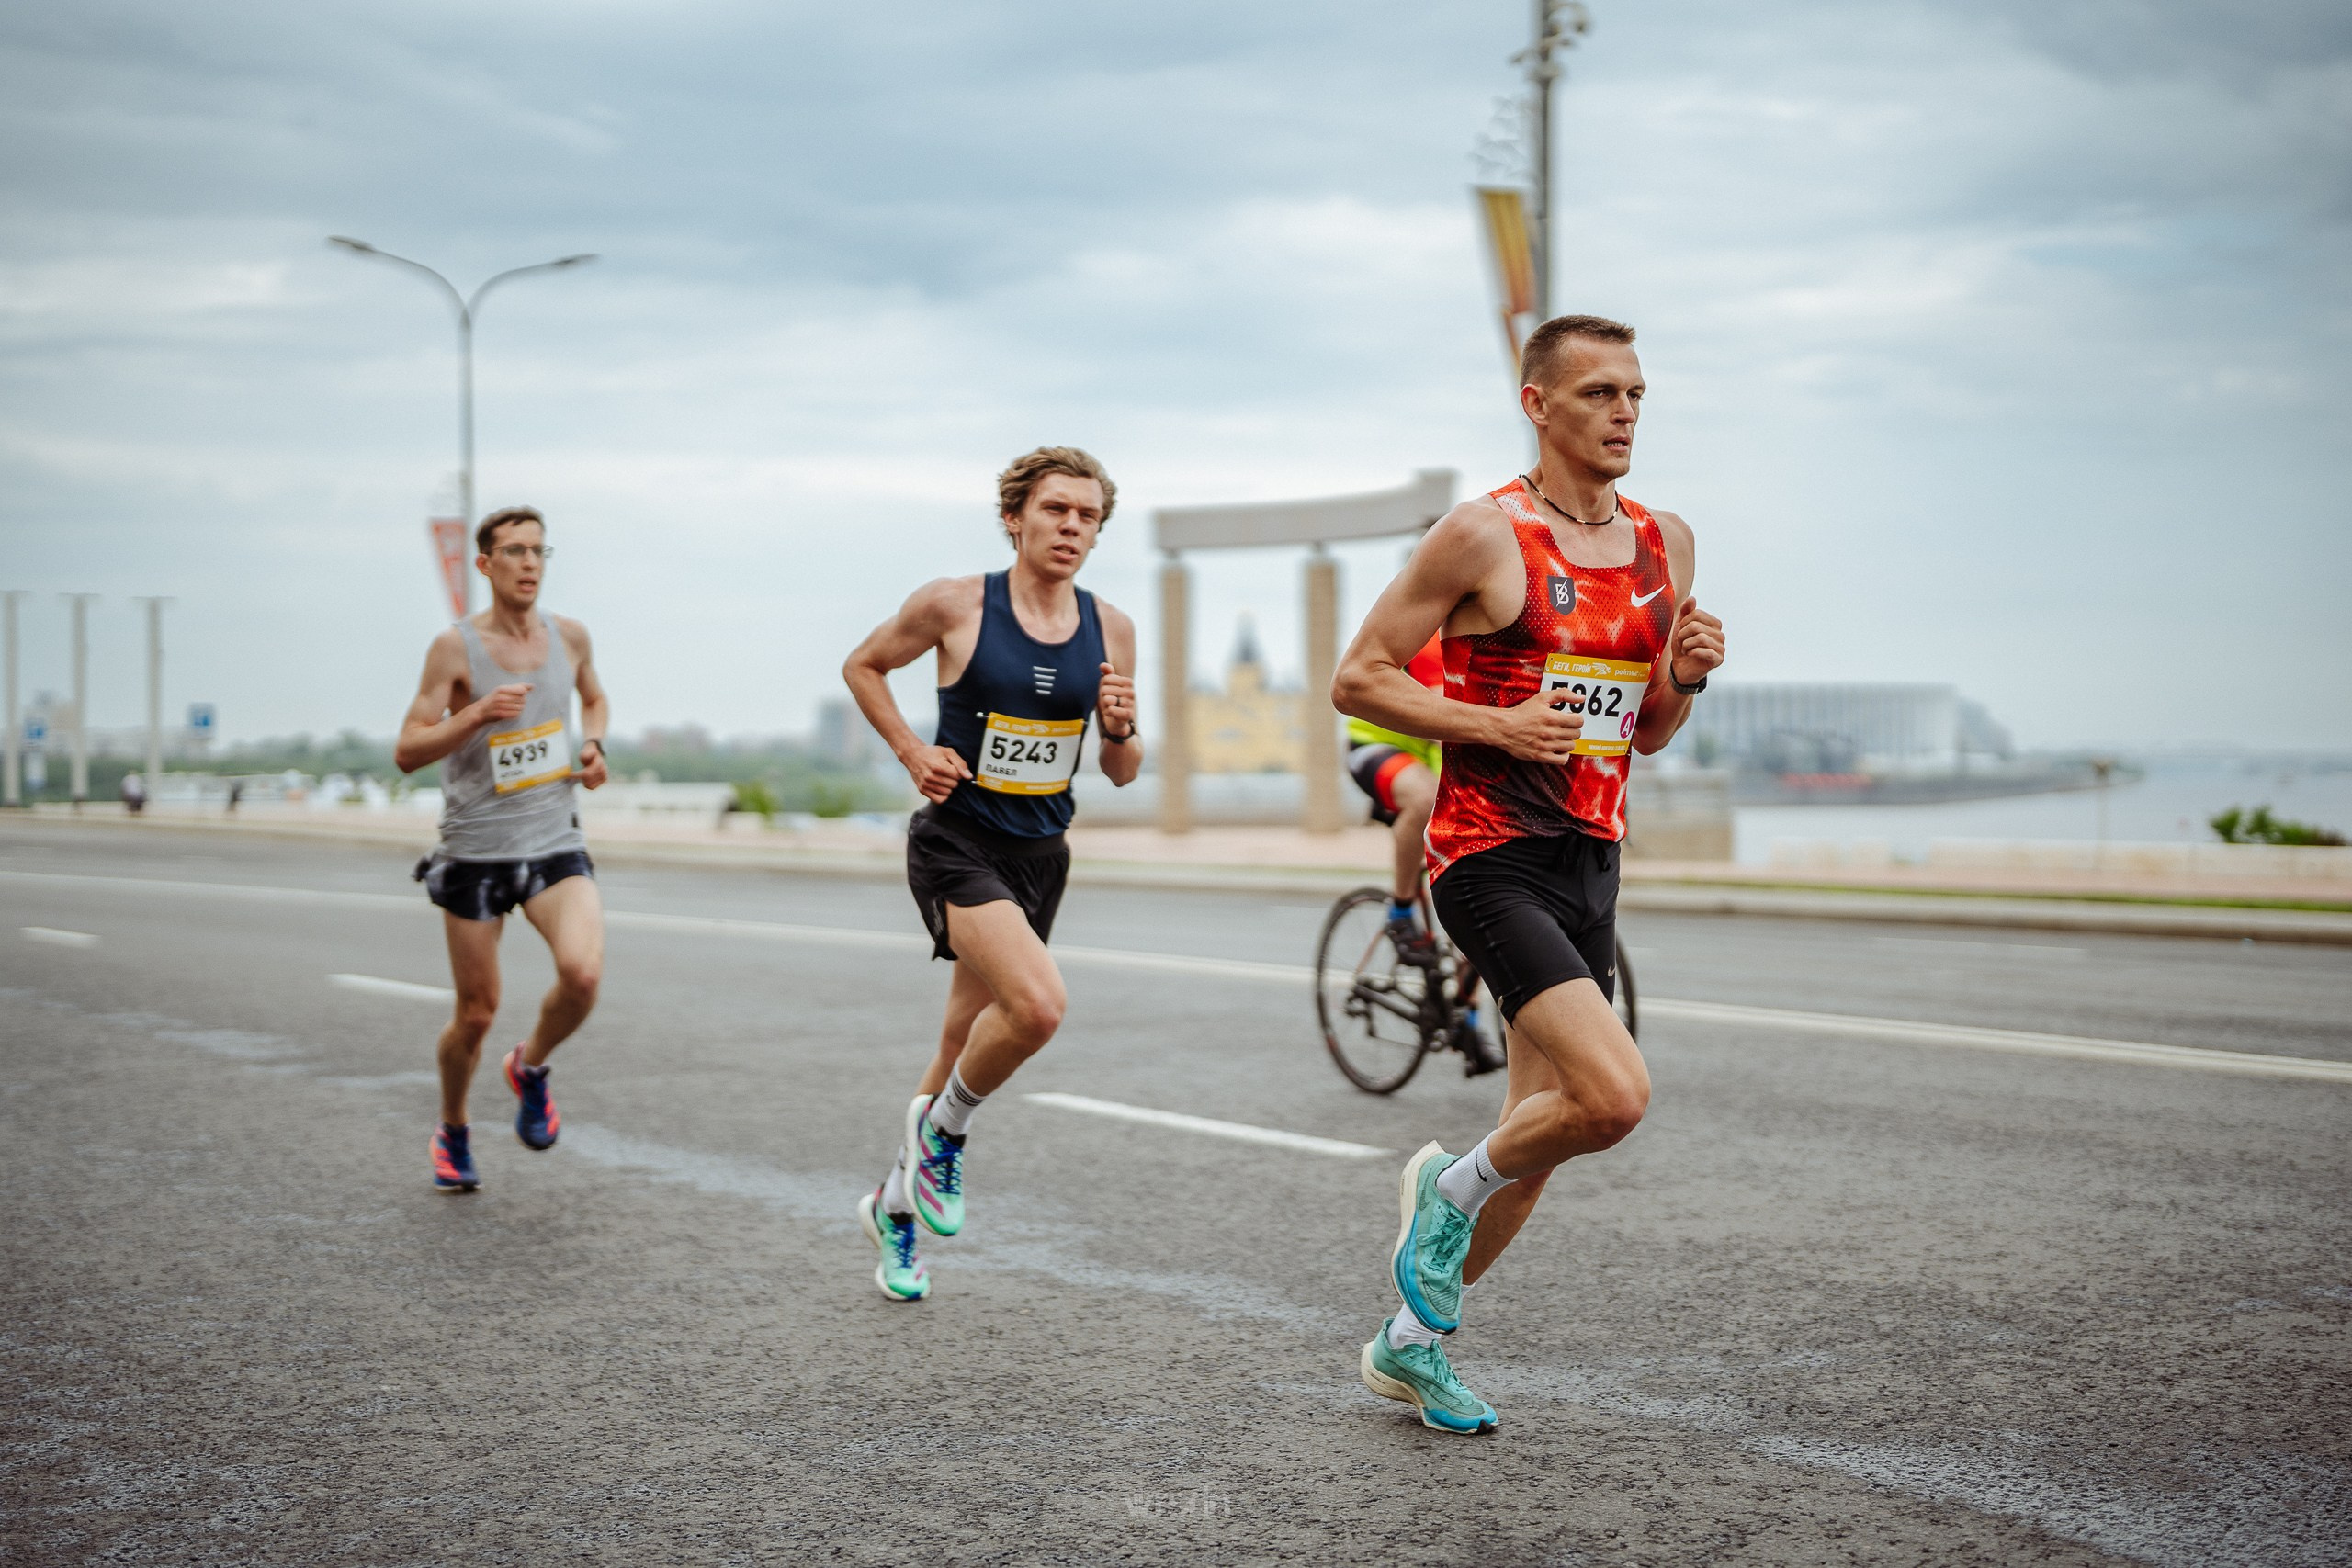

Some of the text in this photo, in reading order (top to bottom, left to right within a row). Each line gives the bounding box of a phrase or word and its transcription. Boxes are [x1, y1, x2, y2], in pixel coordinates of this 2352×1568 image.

[499, 739, 548, 766] 4939
[990, 735, 1058, 764] 5243
[986, 764, 1017, 776] ПАВЕЛ
